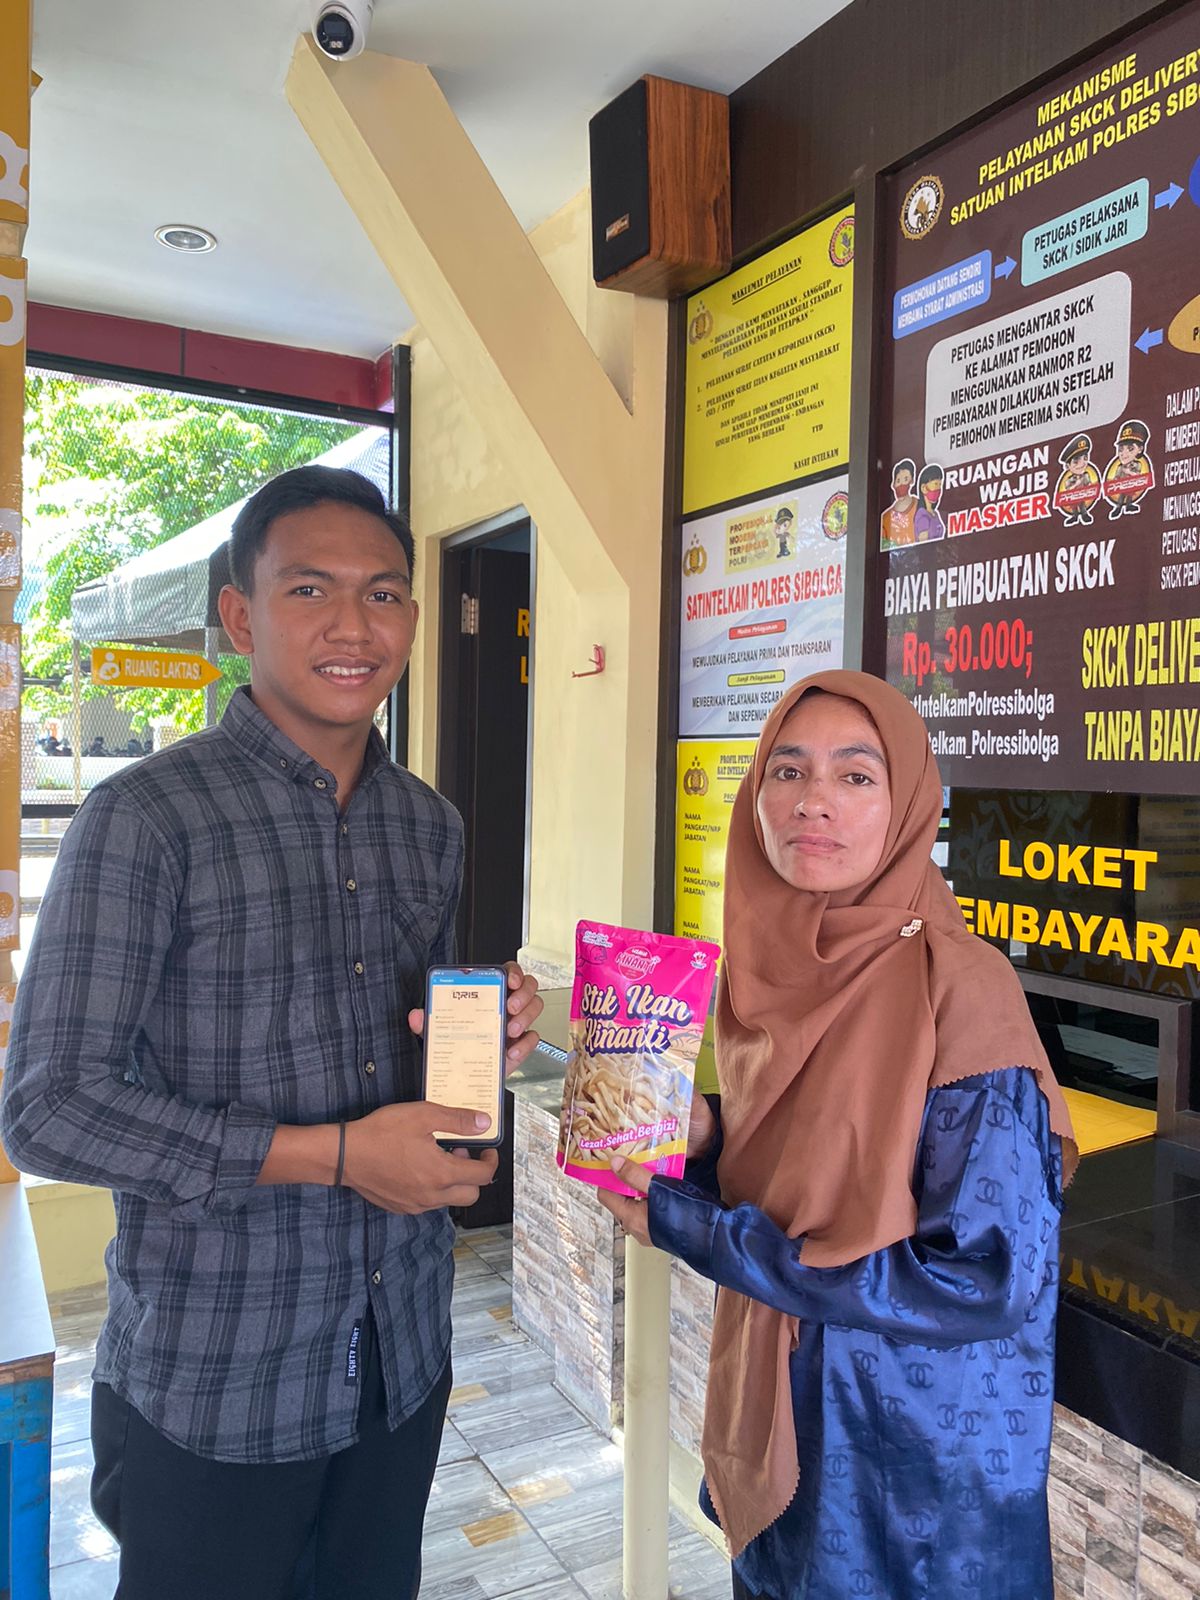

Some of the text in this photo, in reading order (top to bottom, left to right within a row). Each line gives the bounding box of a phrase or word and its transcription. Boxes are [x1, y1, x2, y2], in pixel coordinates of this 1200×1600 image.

[1037, 53, 1137, 127] MEKANISME
[978, 48, 1200, 185] PELAYANAN SKCK DELIVER
[950, 181, 1005, 226] SATUAN
[1009, 138, 1088, 197] INTELKAM
[1093, 101, 1161, 155] POLRES
[1166, 82, 1200, 117] SIB
[1034, 191, 1139, 252] PETUGAS PELAKSANA
[1043, 219, 1128, 270] SKCK / SIDIK JARI
[765, 256, 802, 284] PELAYANAN
[937, 271, 958, 294] DATANG
[959, 260, 982, 283] SENDIRI
[755, 311, 787, 334] PELAYANAN
[951, 295, 1095, 364] PETUGAS MENGANTAR SKCK
[965, 326, 1075, 380] KE ALAMAT PEMOHON
[951, 344, 1092, 406] MENGGUNAKAN RANMOR R2
[933, 362, 1114, 437] (PEMBAYARAN DILAKUKAN SETELAH
[1166, 388, 1193, 418] DALAM
[950, 394, 1090, 450] PEMOHON MENERIMA SKCK)
[1165, 421, 1200, 453] MEMBERI
[945, 446, 1049, 489] RUANGAN
[980, 470, 1049, 503] WAJIB
[948, 494, 1050, 537] MASKER
[1162, 527, 1197, 555] PETUGAS
[686, 563, 843, 621] SATINTELKAM POLRES SIBOLGA
[884, 539, 1116, 617] BIAYA PEMBUATAN SKCK
[1161, 561, 1200, 590] SKCK PEM
[124, 658, 202, 680] RUANG LAKTAS
[692, 639, 832, 668] MEWUJUDKAN PELAYANAN PRIMA DAN TRANSPARAN
[903, 618, 1033, 686] Rp. 30.000;
[1081, 617, 1200, 689] SKCK DELIVE
[692, 693, 726, 708] MEMBERIKAN
[727, 692, 759, 707] PELAYANAN
[728, 710, 740, 723] DAN
[1084, 710, 1144, 761] TANPA
[684, 813, 701, 821] NAMA
[684, 823, 721, 833] PANGKAT/NRP
[684, 834, 706, 842] JABATAN
[683, 866, 700, 874] NAMA
[683, 877, 720, 888] PANGKAT/NRP
[999, 839, 1158, 891] LOKET
[683, 886, 705, 896] JABATAN
[683, 921, 699, 929] NAMA
[452, 991, 479, 1000] QRIS
[581, 982, 690, 1024] Stik Ikan
[586, 1017, 669, 1053] Kinanti
